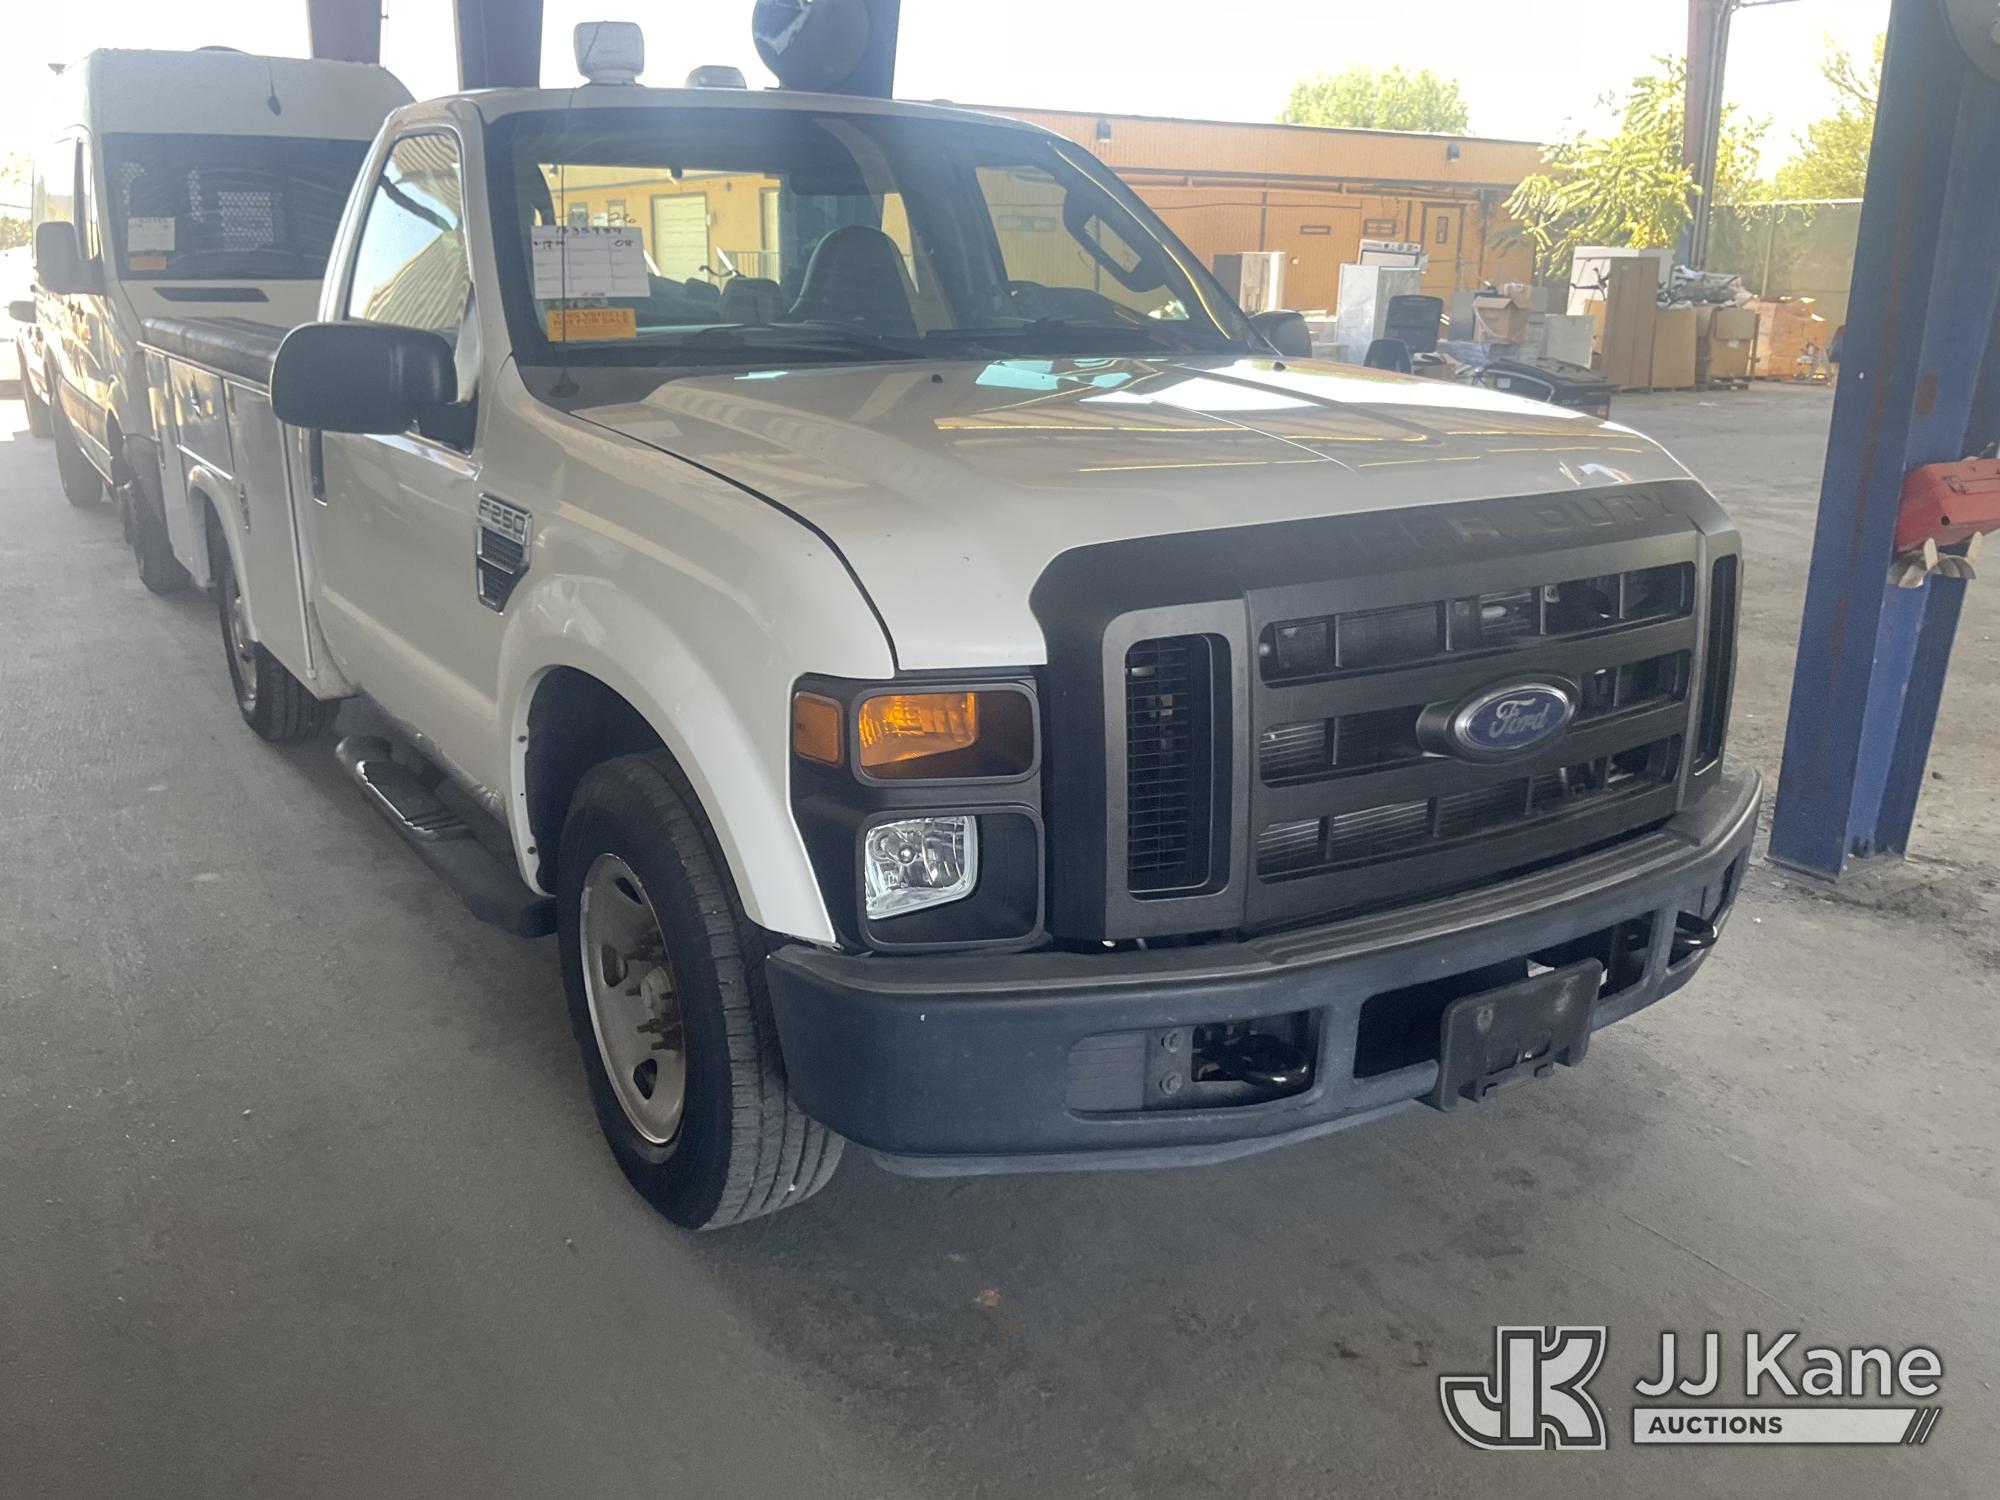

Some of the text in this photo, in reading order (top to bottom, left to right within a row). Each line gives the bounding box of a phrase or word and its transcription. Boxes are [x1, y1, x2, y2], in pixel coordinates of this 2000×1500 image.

[582, 310, 627, 318] VEHICLE
[601, 317, 628, 325] SALE
[1488, 697, 1551, 739] Ford
